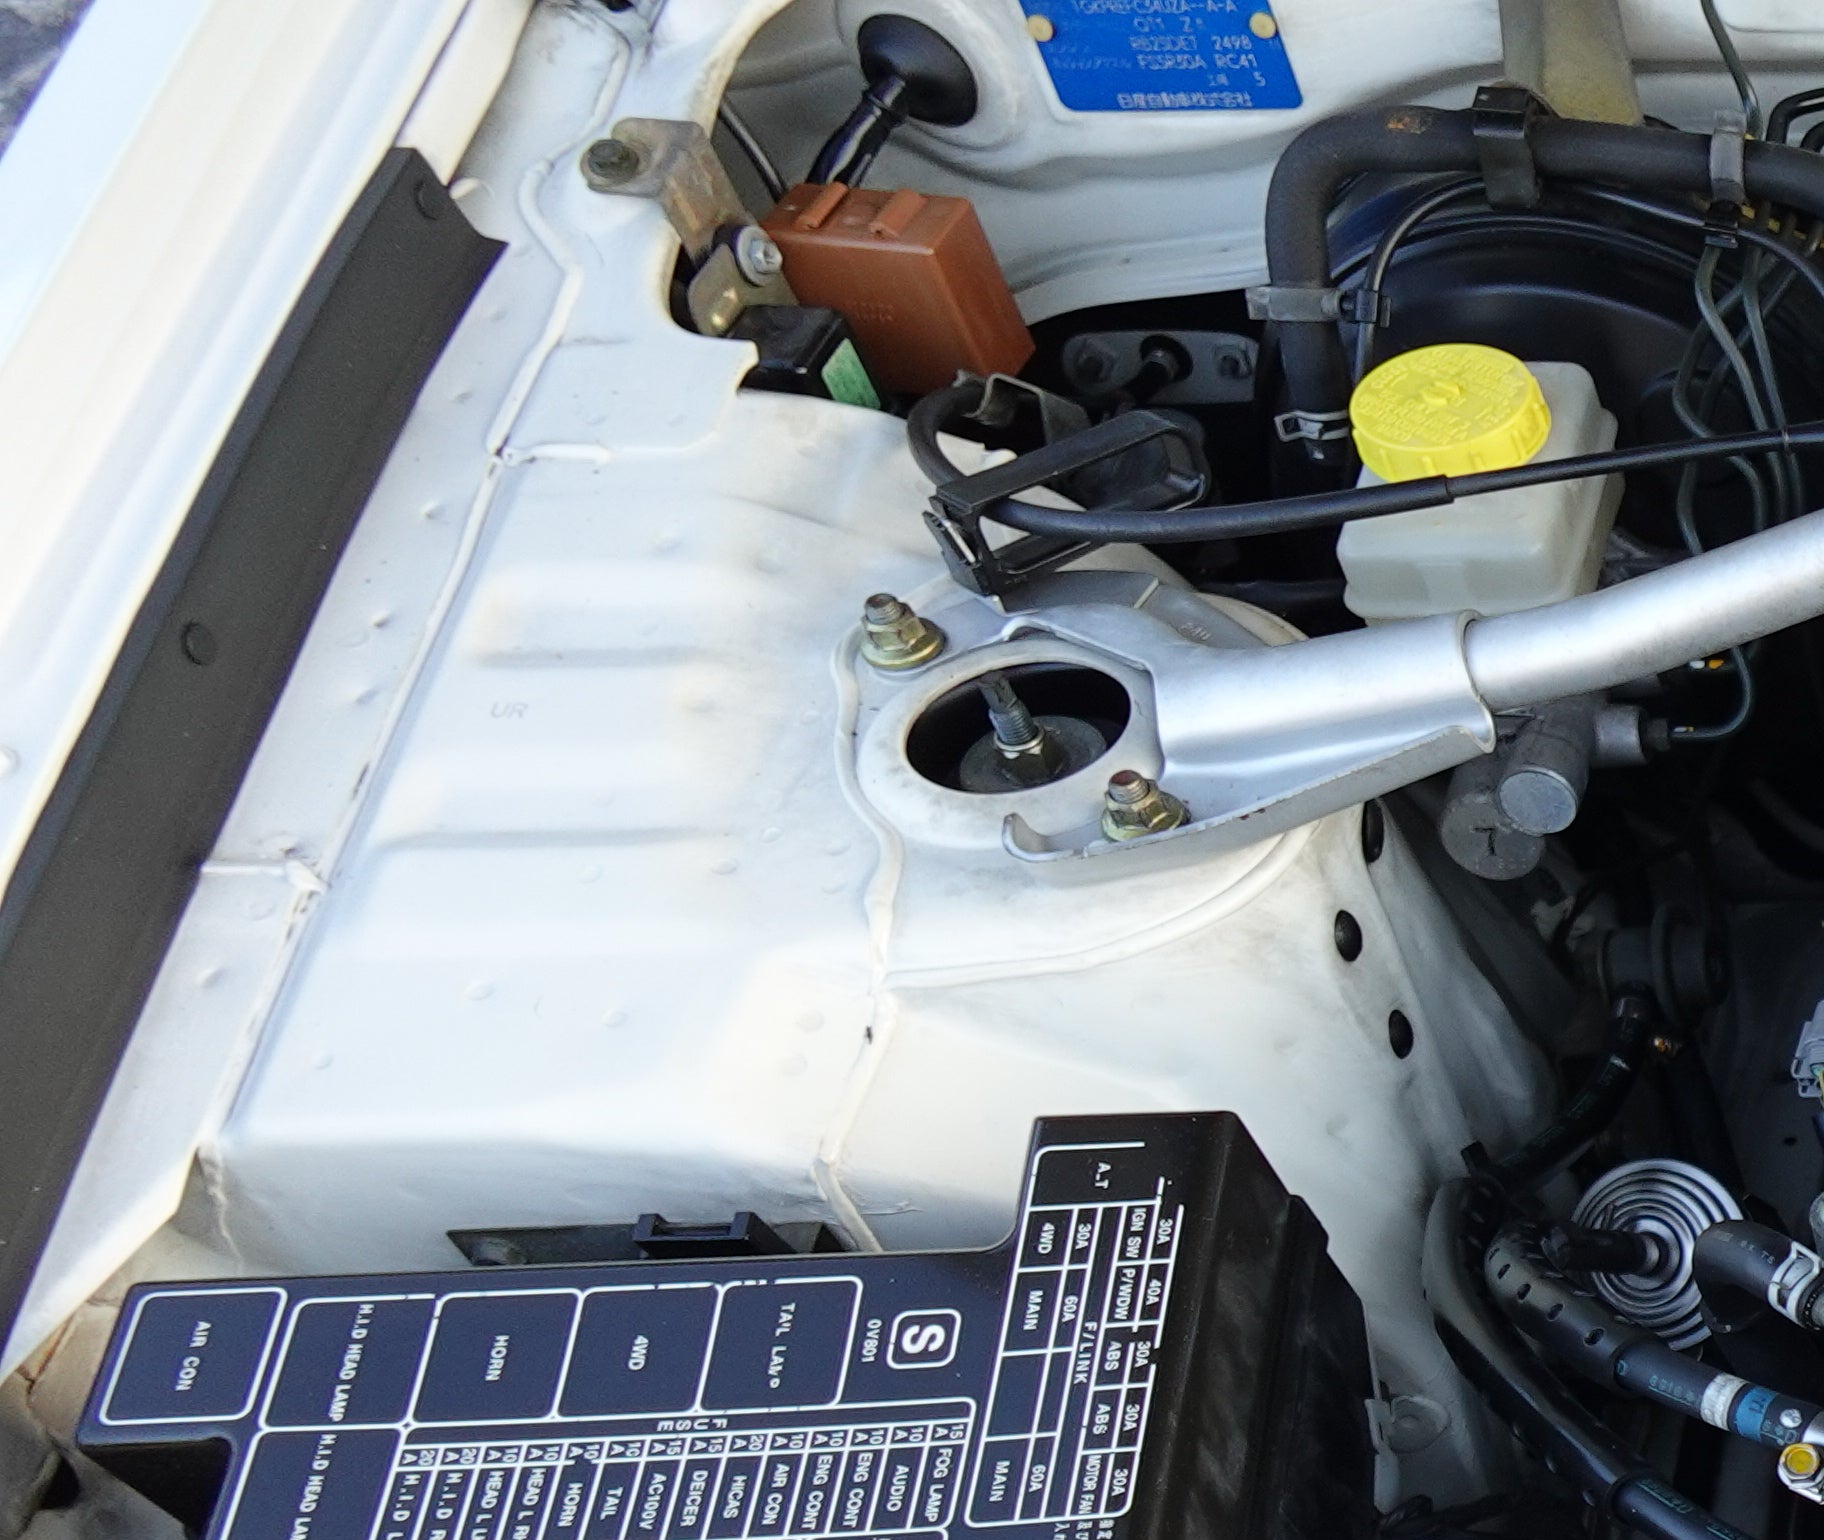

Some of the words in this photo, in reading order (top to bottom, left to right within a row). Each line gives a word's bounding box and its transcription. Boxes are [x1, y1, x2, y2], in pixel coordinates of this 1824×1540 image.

[1075, 1222, 1092, 1250] 30A
[1130, 1207, 1147, 1232] IGN
[1156, 1218, 1174, 1246] 30A
[1037, 1222, 1056, 1255] 4WD
[1125, 1236, 1142, 1259] SW
[1023, 1289, 1044, 1331] MAIN
[1061, 1295, 1079, 1323] 60A
[1114, 1267, 1136, 1320] P/WDW
[1145, 1278, 1162, 1306] 40A
[189, 1320, 212, 1348] AIR
[351, 1303, 375, 1340] H.I.D
[901, 1324, 946, 1354] S
[339, 1343, 364, 1381] HEAD
[484, 1334, 510, 1382] HORN
[627, 1334, 650, 1372] 4WD
[1073, 1321, 1099, 1385] F/LINK
[1104, 1340, 1122, 1371] ABS
[1134, 1340, 1152, 1368] 30A
[174, 1356, 201, 1392] CON
[327, 1384, 351, 1423] LAMP
[1092, 1403, 1111, 1435] ABS
[1122, 1403, 1141, 1431] 30A
[311, 1434, 337, 1471] H.I.D
[813, 1455, 834, 1486] ENG
[853, 1452, 874, 1484] ENG
[934, 1448, 953, 1479] FOG
[481, 1471, 505, 1509] HEAD
[522, 1468, 547, 1506] HEAD
[771, 1463, 790, 1488] AIR
[886, 1465, 910, 1512] AUDIO
[988, 1460, 1011, 1502] MAIN
[1028, 1464, 1047, 1493] 60A
[1082, 1454, 1101, 1492] MOTOR
[1111, 1468, 1129, 1497] 30A
[299, 1475, 325, 1513] HEAD
[392, 1474, 422, 1522] H.I.D
[436, 1472, 463, 1520] H.I.D
[557, 1483, 583, 1527] HORN
[600, 1486, 624, 1520] TAIL
[638, 1473, 668, 1531] AC100V
[680, 1470, 709, 1527] DEICER
[722, 1475, 747, 1519] HICAS
[761, 1493, 784, 1526] CON
[801, 1490, 824, 1530] CONT
[843, 1488, 865, 1528] CONT
[924, 1484, 945, 1522] LAMP
[1078, 1493, 1095, 1515] FAN
[475, 1513, 493, 1523] L
[517, 1510, 534, 1521] L
